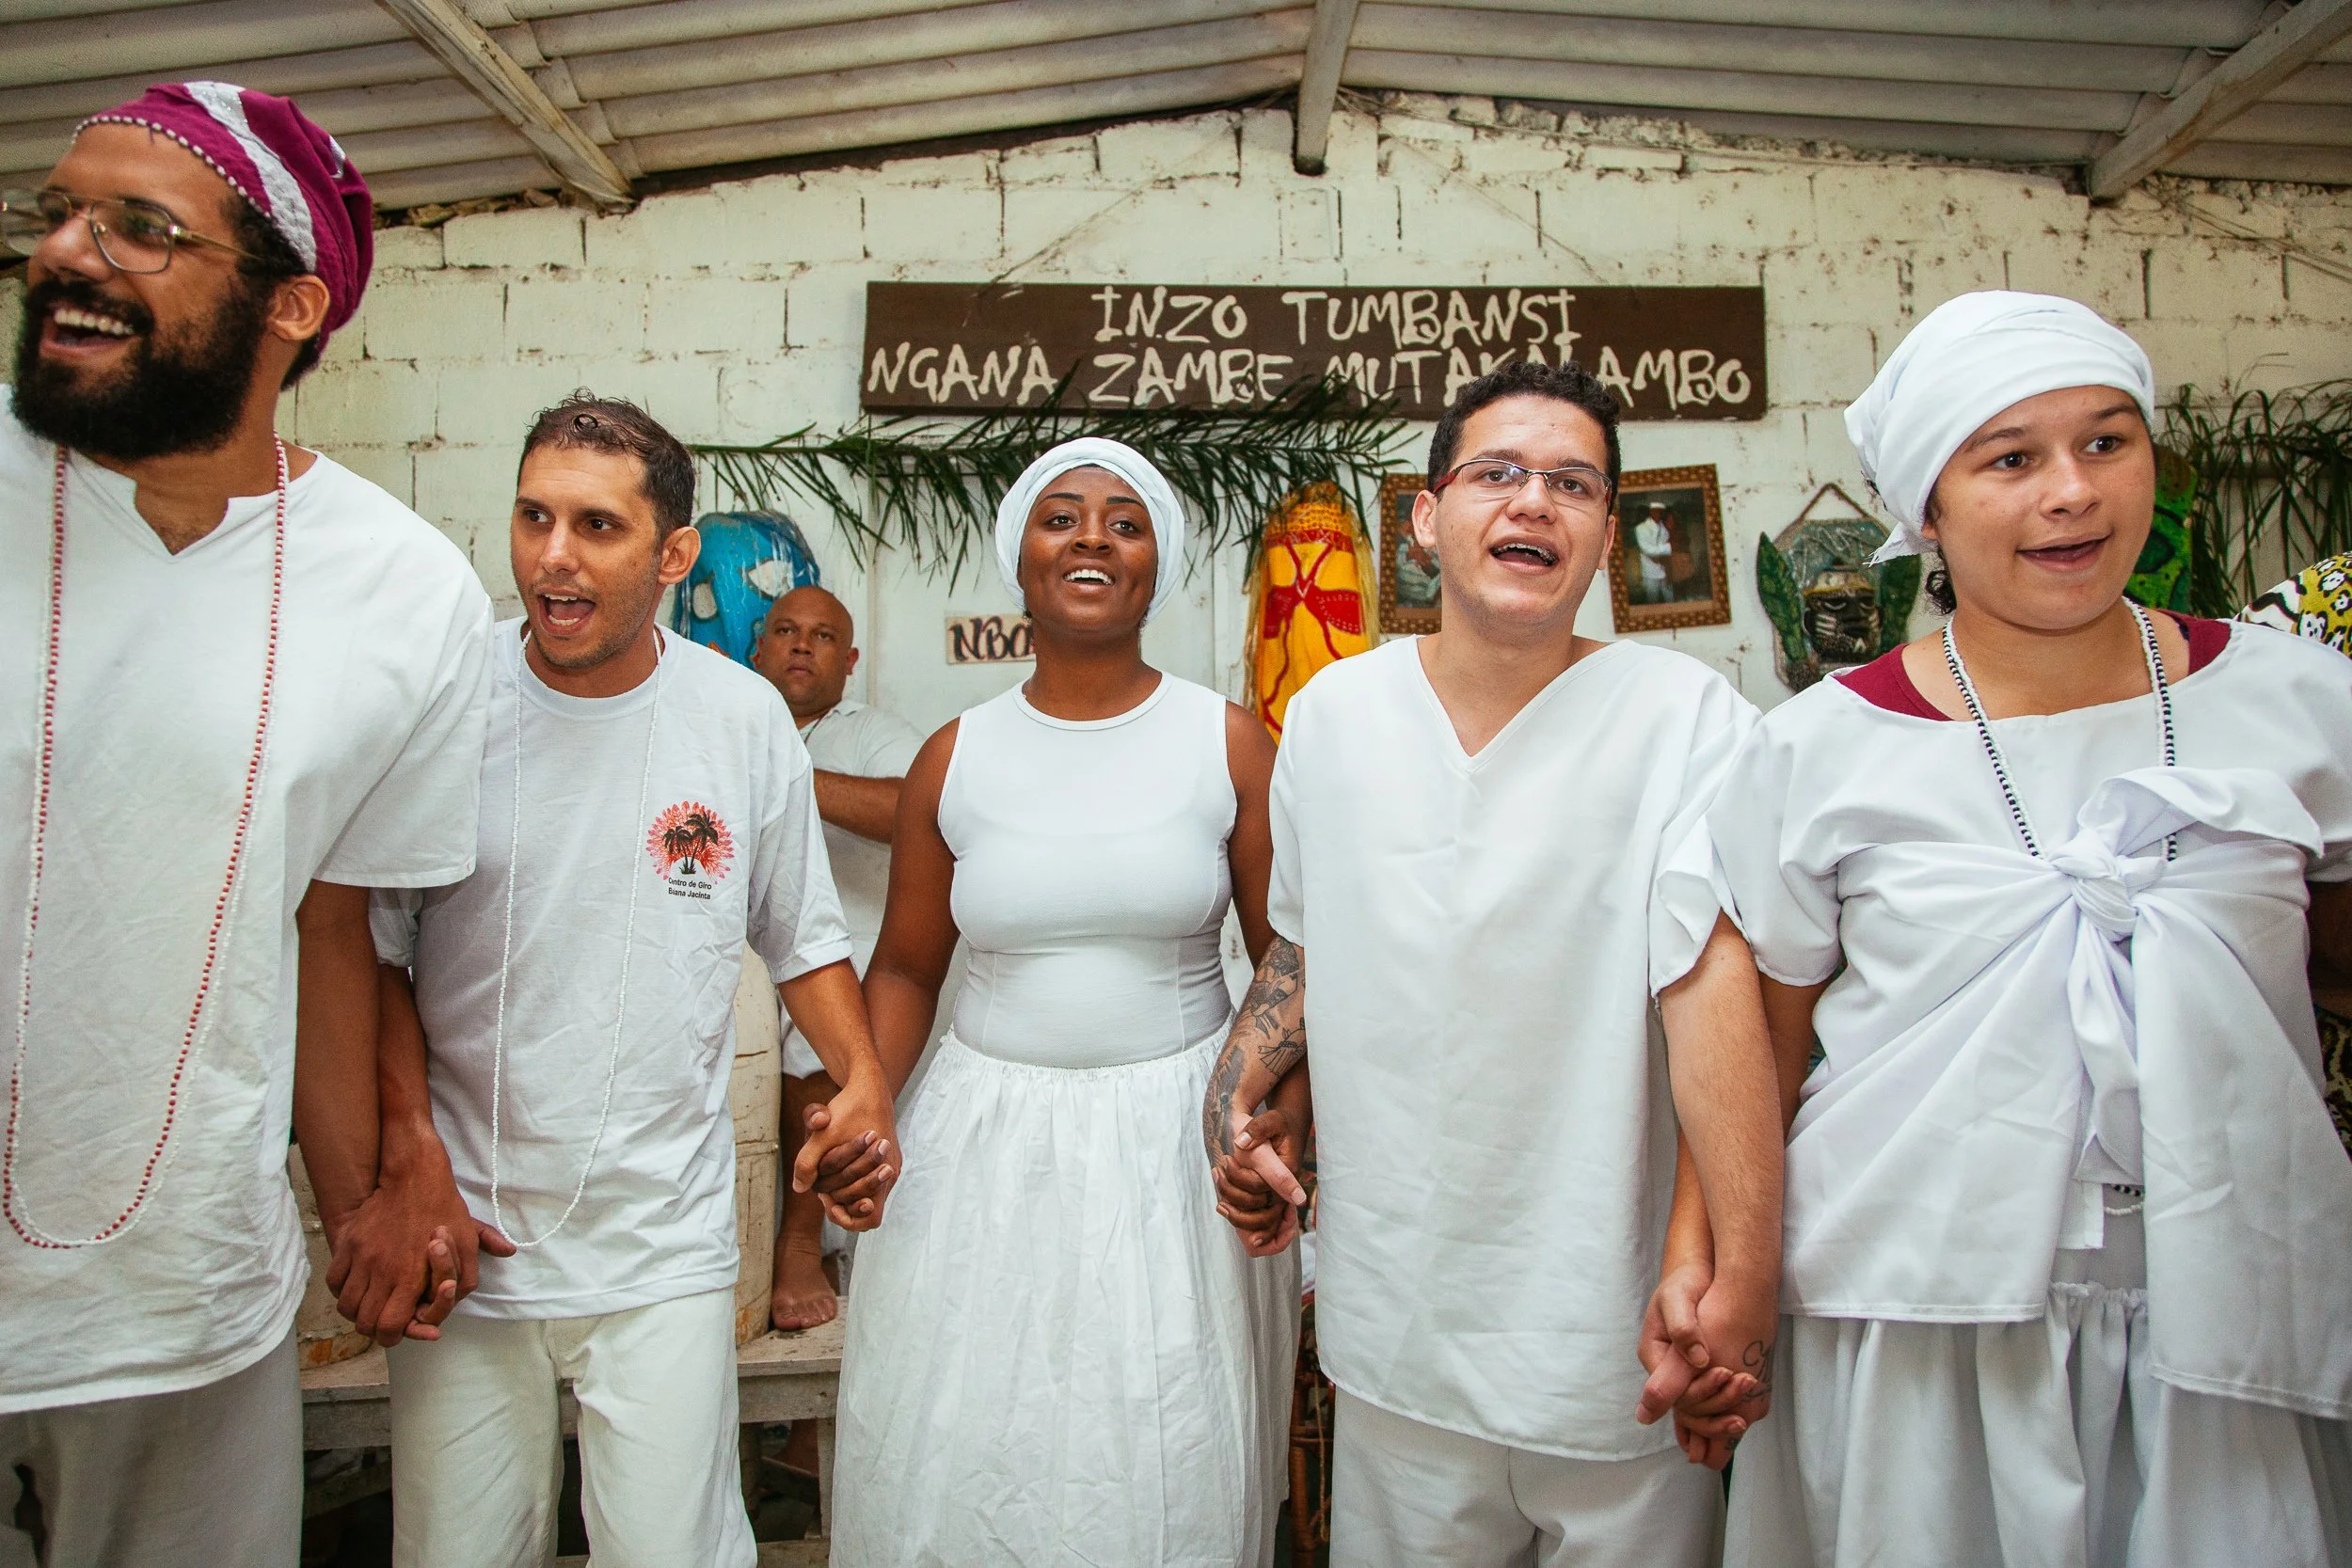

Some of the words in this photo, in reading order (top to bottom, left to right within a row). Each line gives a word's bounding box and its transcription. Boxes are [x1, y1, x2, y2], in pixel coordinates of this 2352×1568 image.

[1091, 286, 1248, 342] INZO
[1281, 288, 1581, 349] TUMBANSI
[867, 341, 1058, 405] NGANA
[1089, 346, 1294, 407] ZAMBE
[688, 890, 711, 900] Jacinta
[698, 881, 712, 890] Giro
